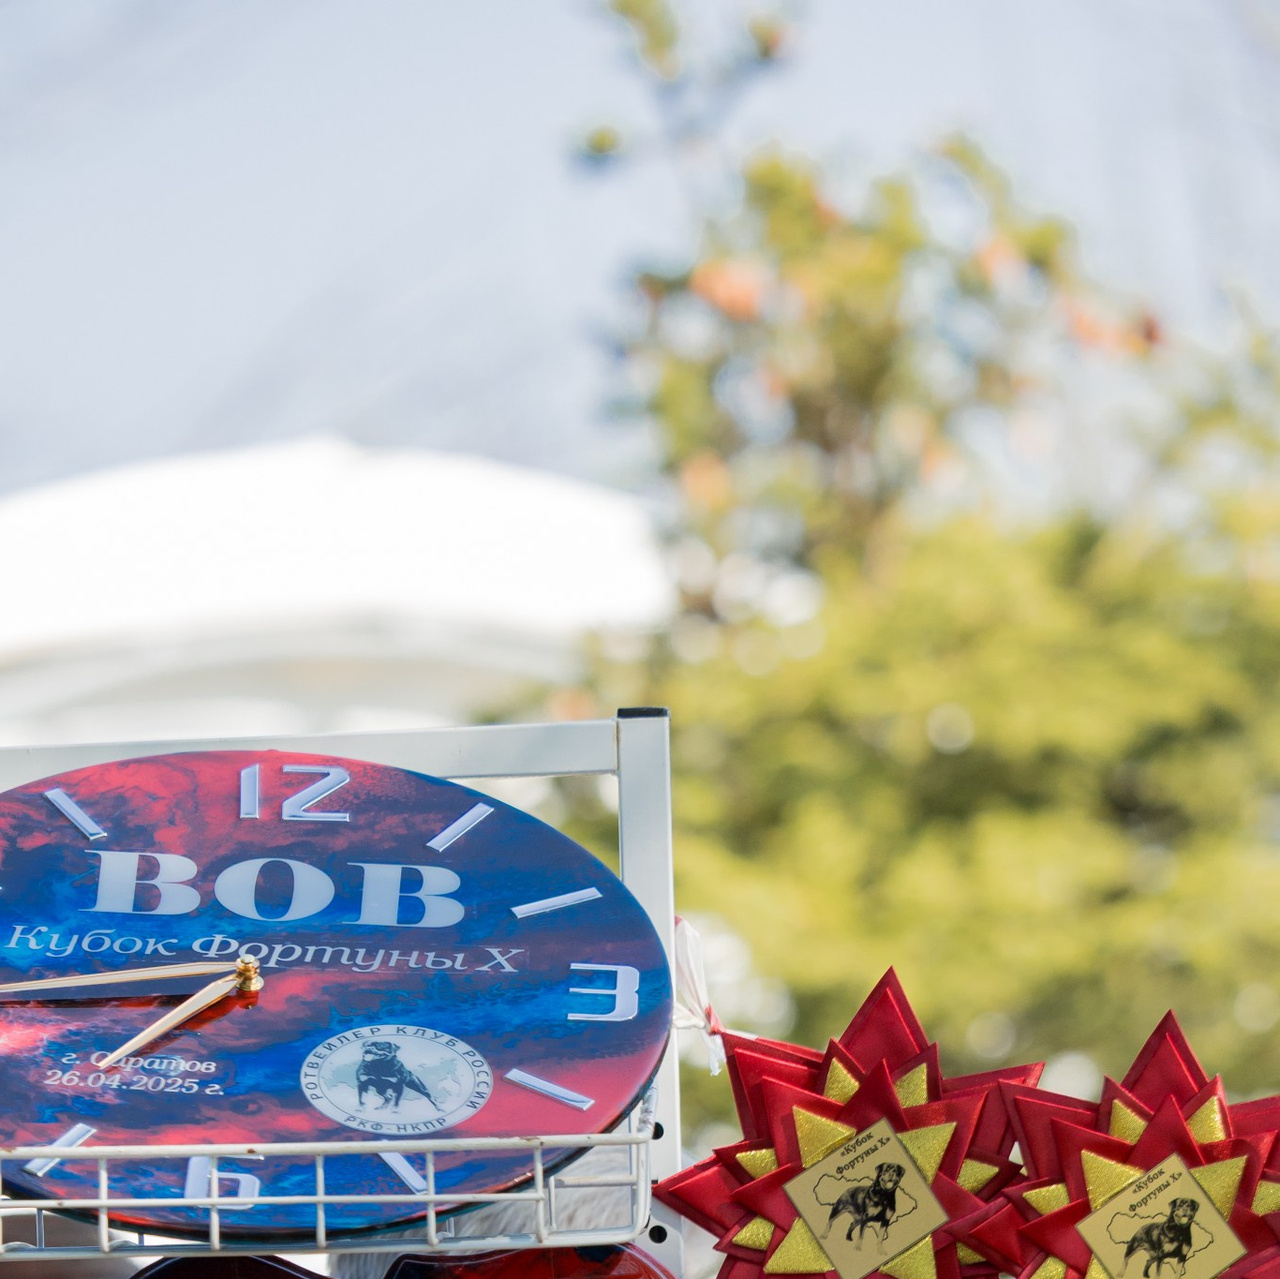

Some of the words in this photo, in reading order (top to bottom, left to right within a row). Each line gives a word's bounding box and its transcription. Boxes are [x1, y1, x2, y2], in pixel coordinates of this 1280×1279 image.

[239, 763, 352, 822] 12
[78, 849, 466, 929] BOB
[4, 925, 179, 958] Кубок
[191, 933, 469, 973] Фортуны
[566, 961, 641, 1022] 3
[43, 1070, 200, 1095] 26.04.2025
[396, 1026, 459, 1047] КЛУБ
[462, 1050, 491, 1110] РОССИИ
[183, 1154, 265, 1211] 6
